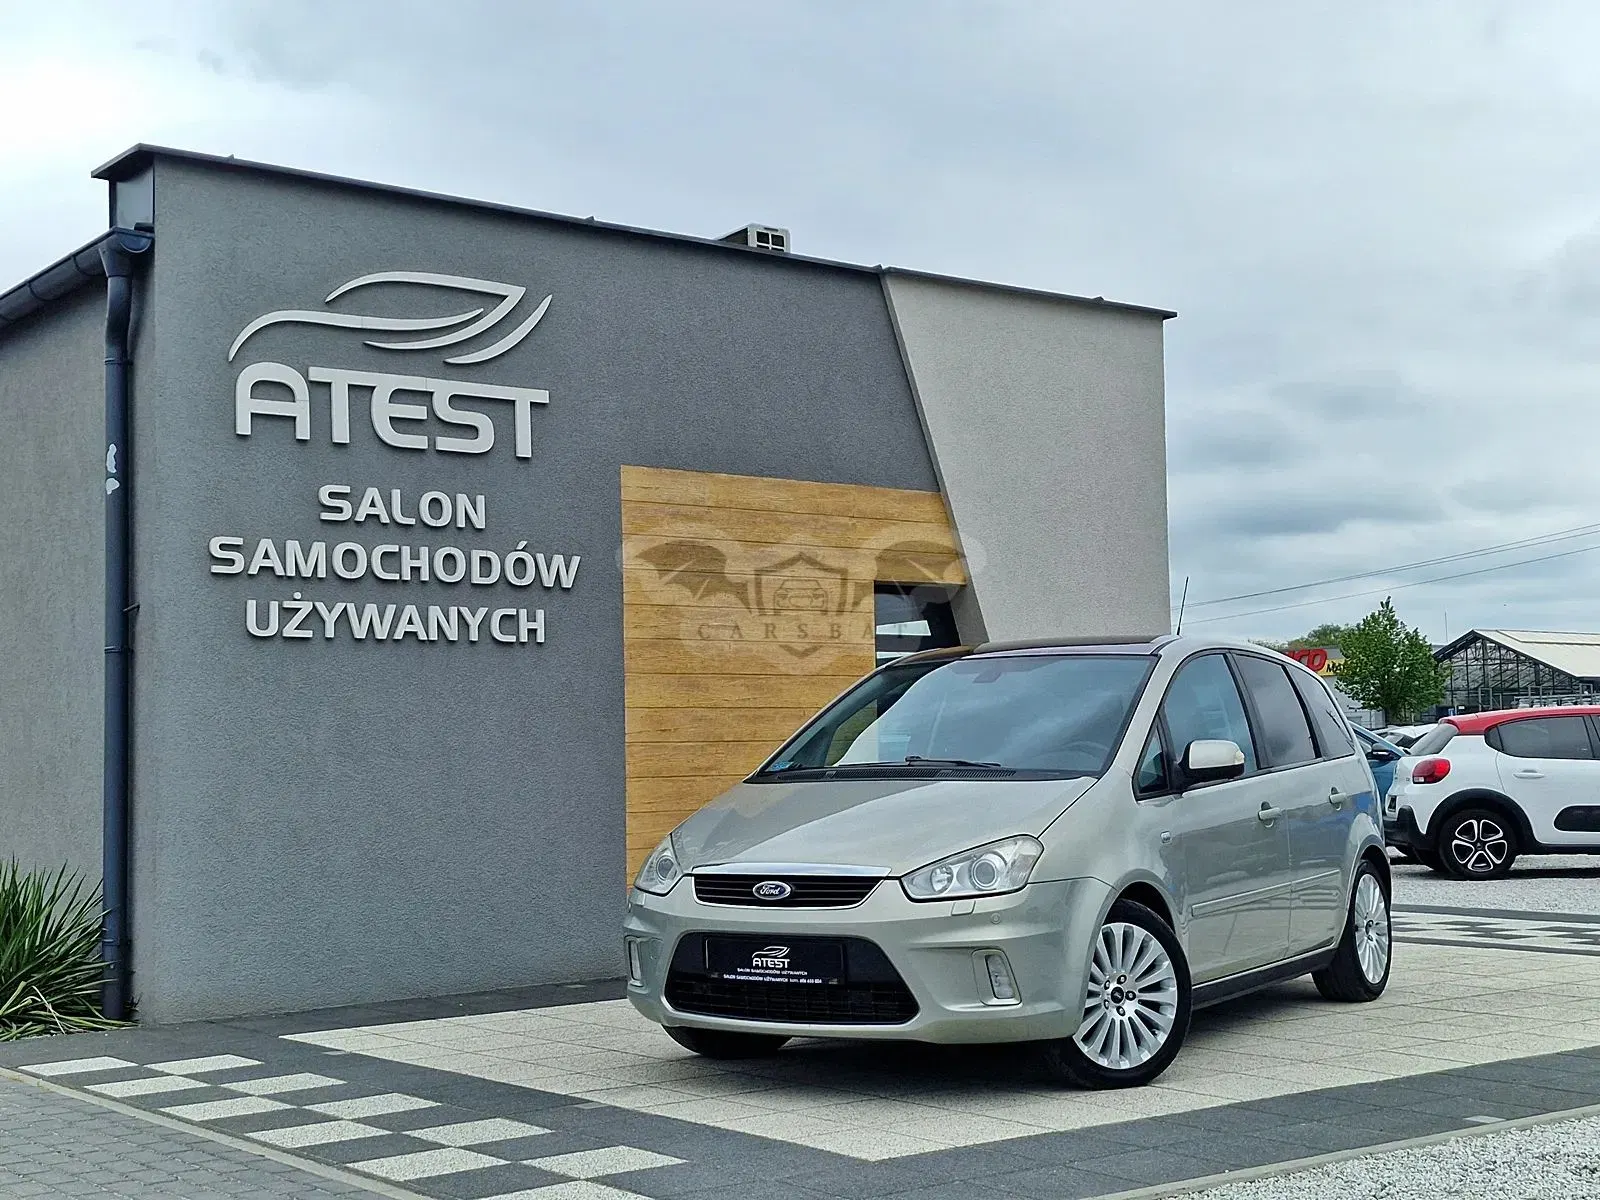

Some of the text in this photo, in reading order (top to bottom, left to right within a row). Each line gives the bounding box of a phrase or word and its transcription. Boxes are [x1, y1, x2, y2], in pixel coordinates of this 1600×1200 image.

[235, 362, 549, 458] ATEST
[318, 484, 486, 529] SALON
[208, 536, 581, 589] SAMOCHODÓW
[245, 591, 546, 643] UŻYWANYCH
[760, 884, 781, 895] Ford
[752, 958, 790, 968] ATEST
